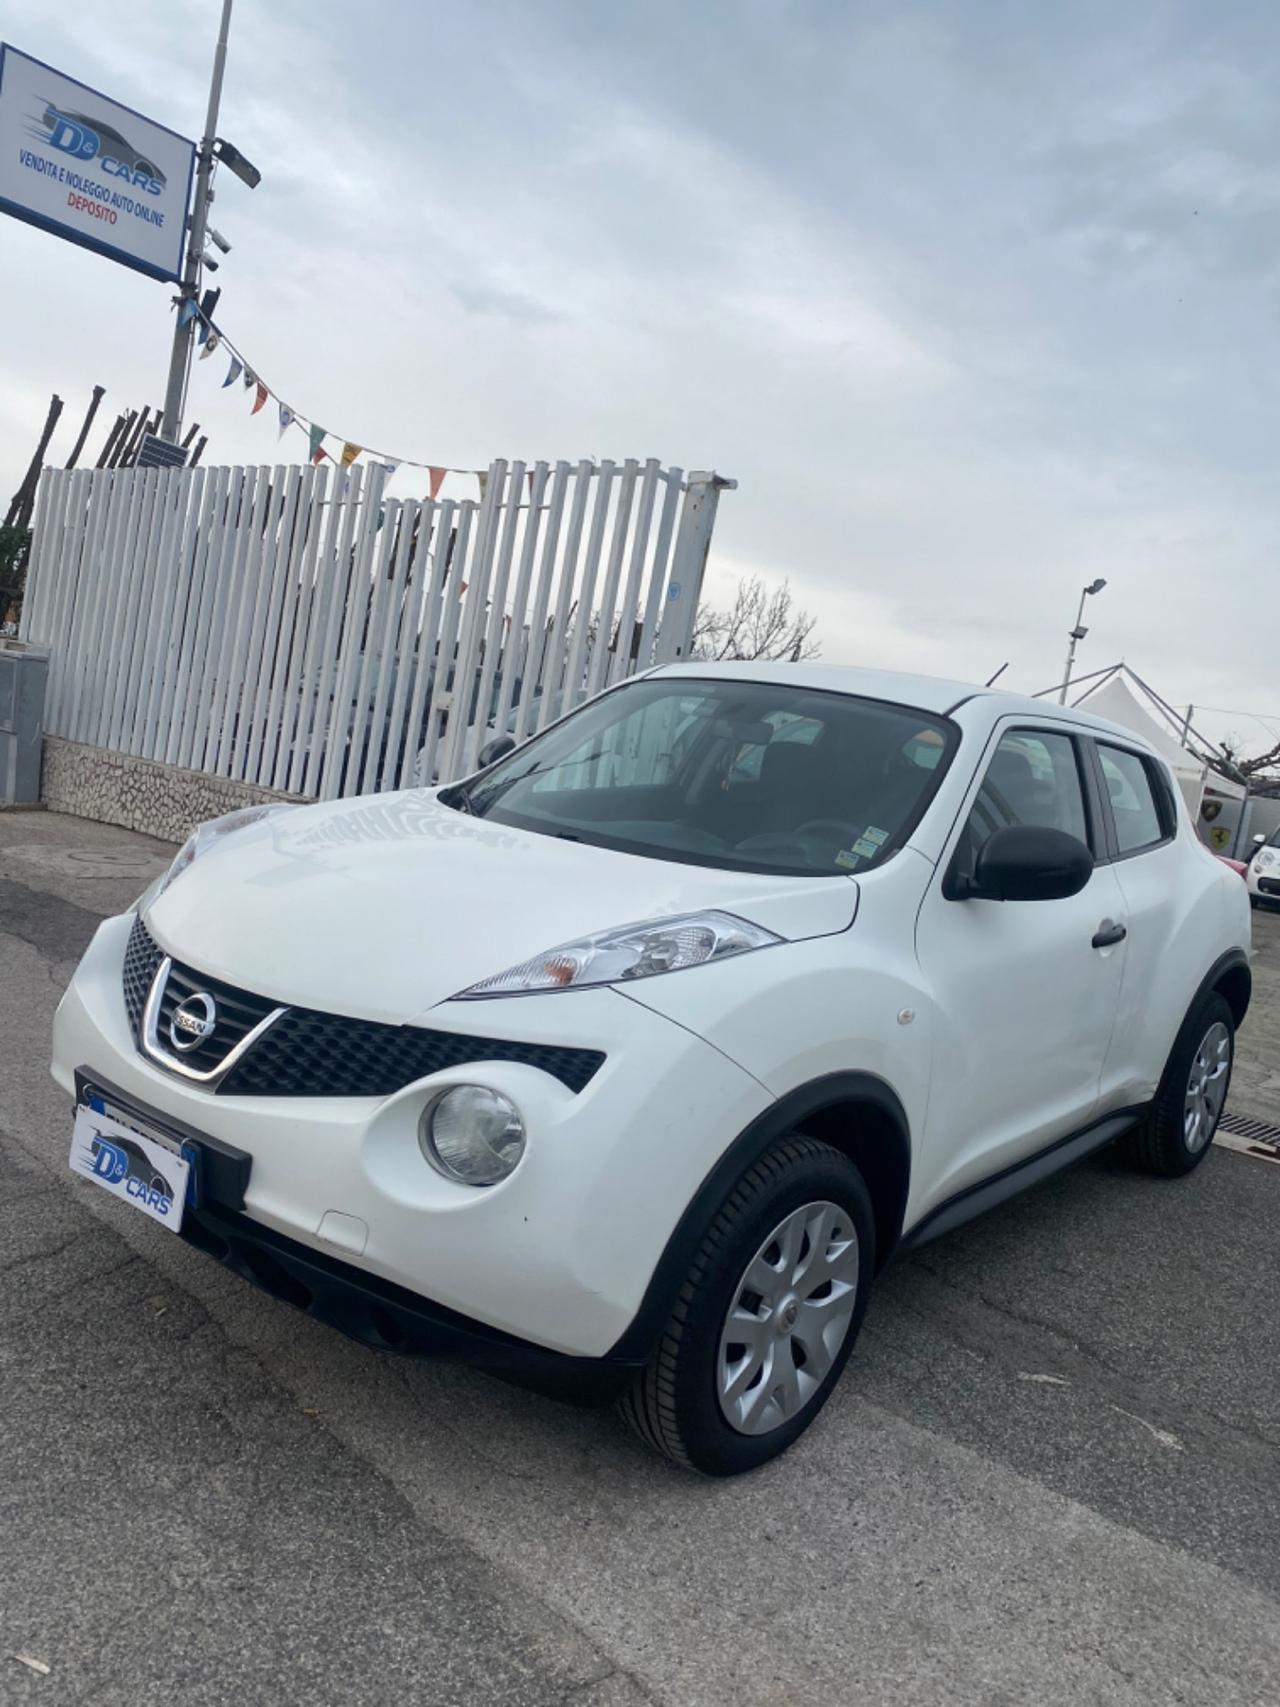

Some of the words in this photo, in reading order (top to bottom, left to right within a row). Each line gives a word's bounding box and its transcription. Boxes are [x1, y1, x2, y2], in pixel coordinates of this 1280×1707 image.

[20, 149, 57, 178] VENDITA
[59, 170, 64, 182] E
[66, 171, 110, 202] NOLEGGIO
[111, 194, 134, 213] AUTO
[135, 203, 165, 228] ONLINE
[101, 156, 162, 196] CARS
[67, 193, 118, 225] DEPOSITO
[126, 1177, 172, 1215] CARS
